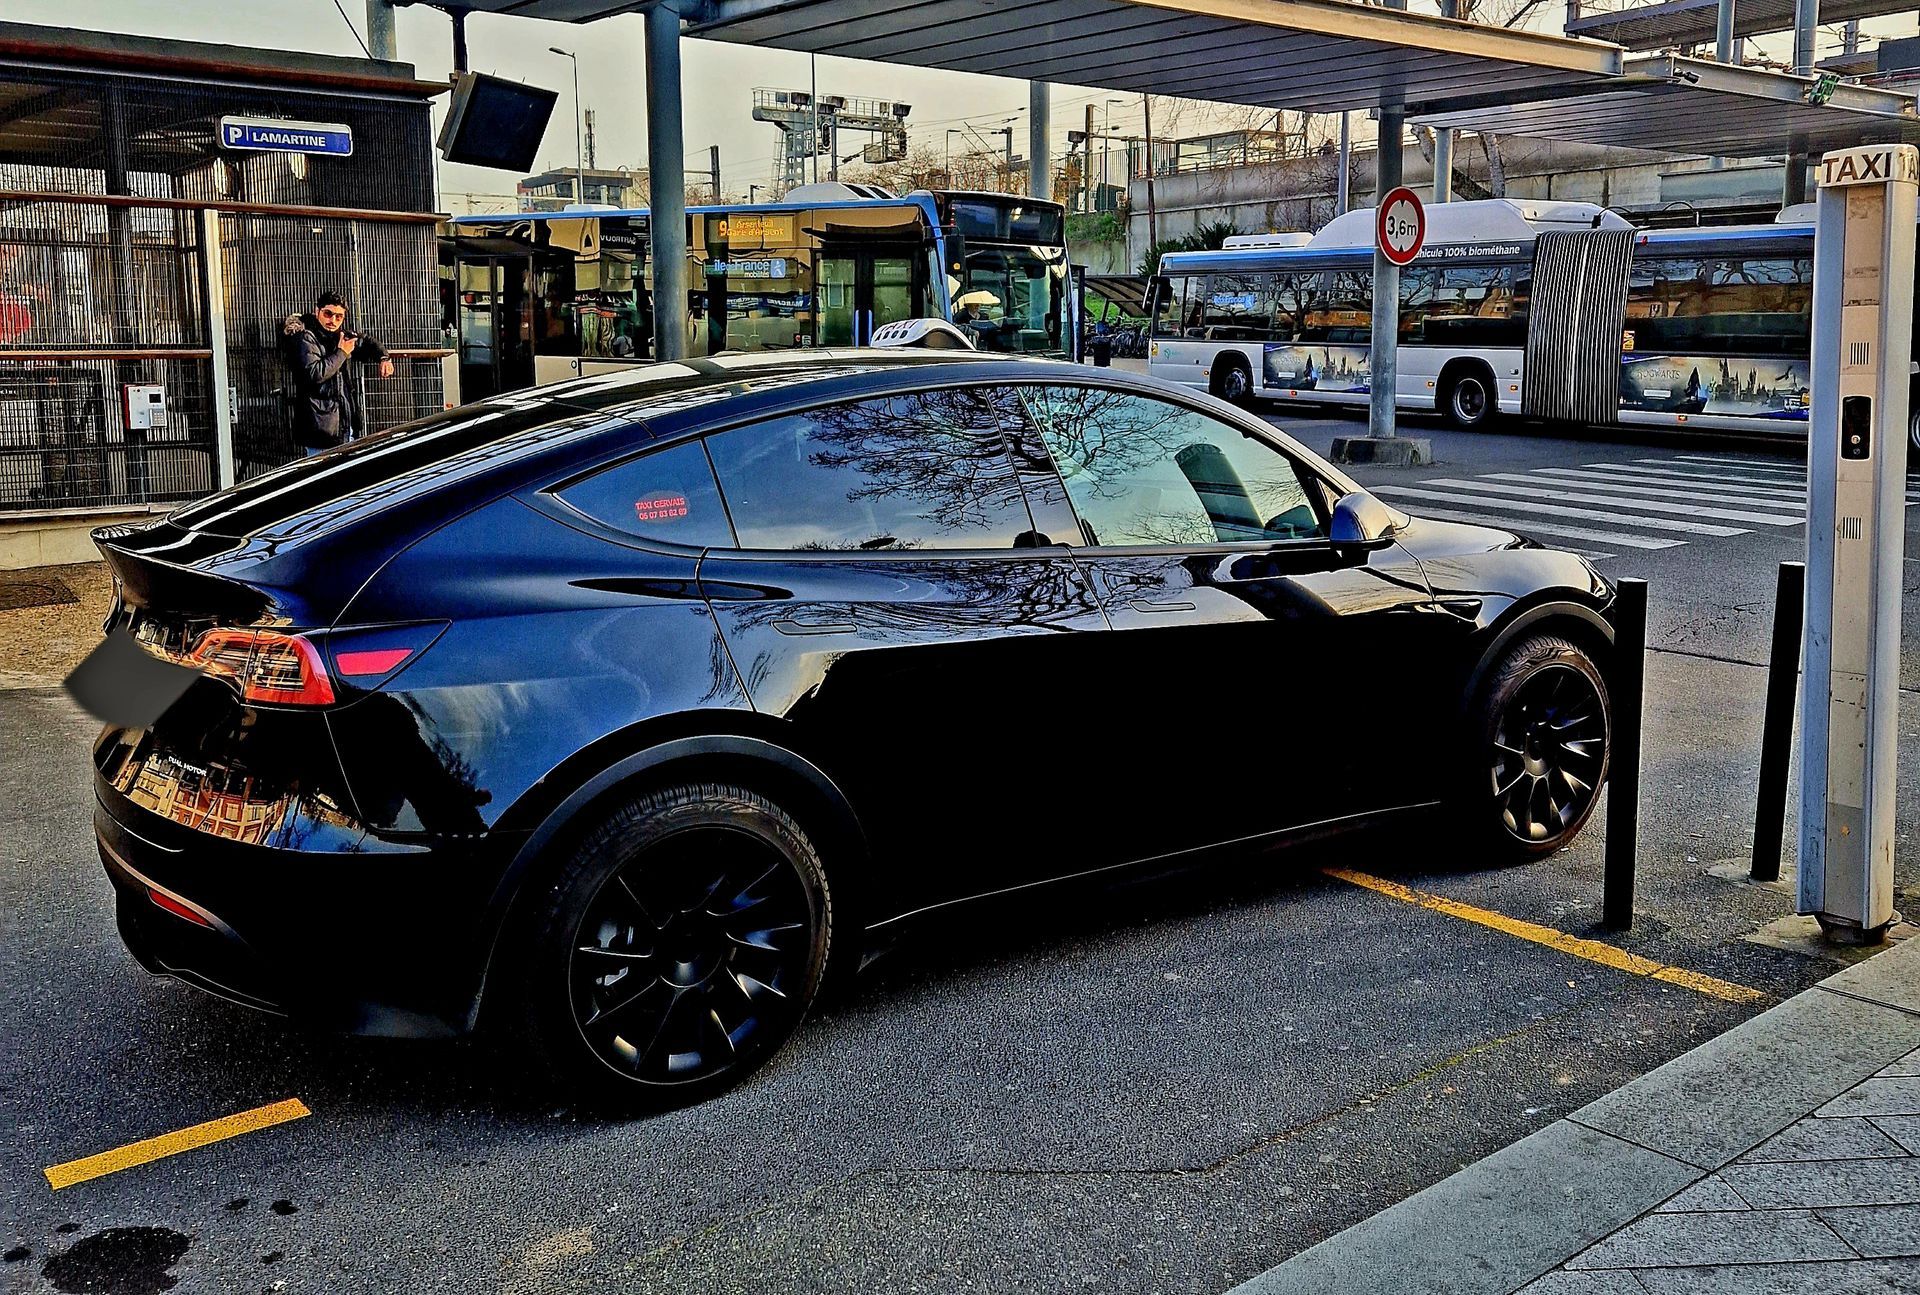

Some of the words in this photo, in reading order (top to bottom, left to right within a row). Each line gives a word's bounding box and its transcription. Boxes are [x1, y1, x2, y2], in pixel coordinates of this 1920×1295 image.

[229, 126, 243, 144] P
[252, 131, 326, 147] LAMARTINE
[1823, 151, 1892, 184] TAXI
[1387, 216, 1417, 239] 3,6m
[1416, 249, 1443, 258] hicule
[1444, 247, 1467, 257] 100%
[1469, 245, 1520, 256] biométhane
[635, 502, 653, 510] TAXI
[654, 498, 685, 508] GERVAIS
[183, 763, 207, 776] MOTOR
